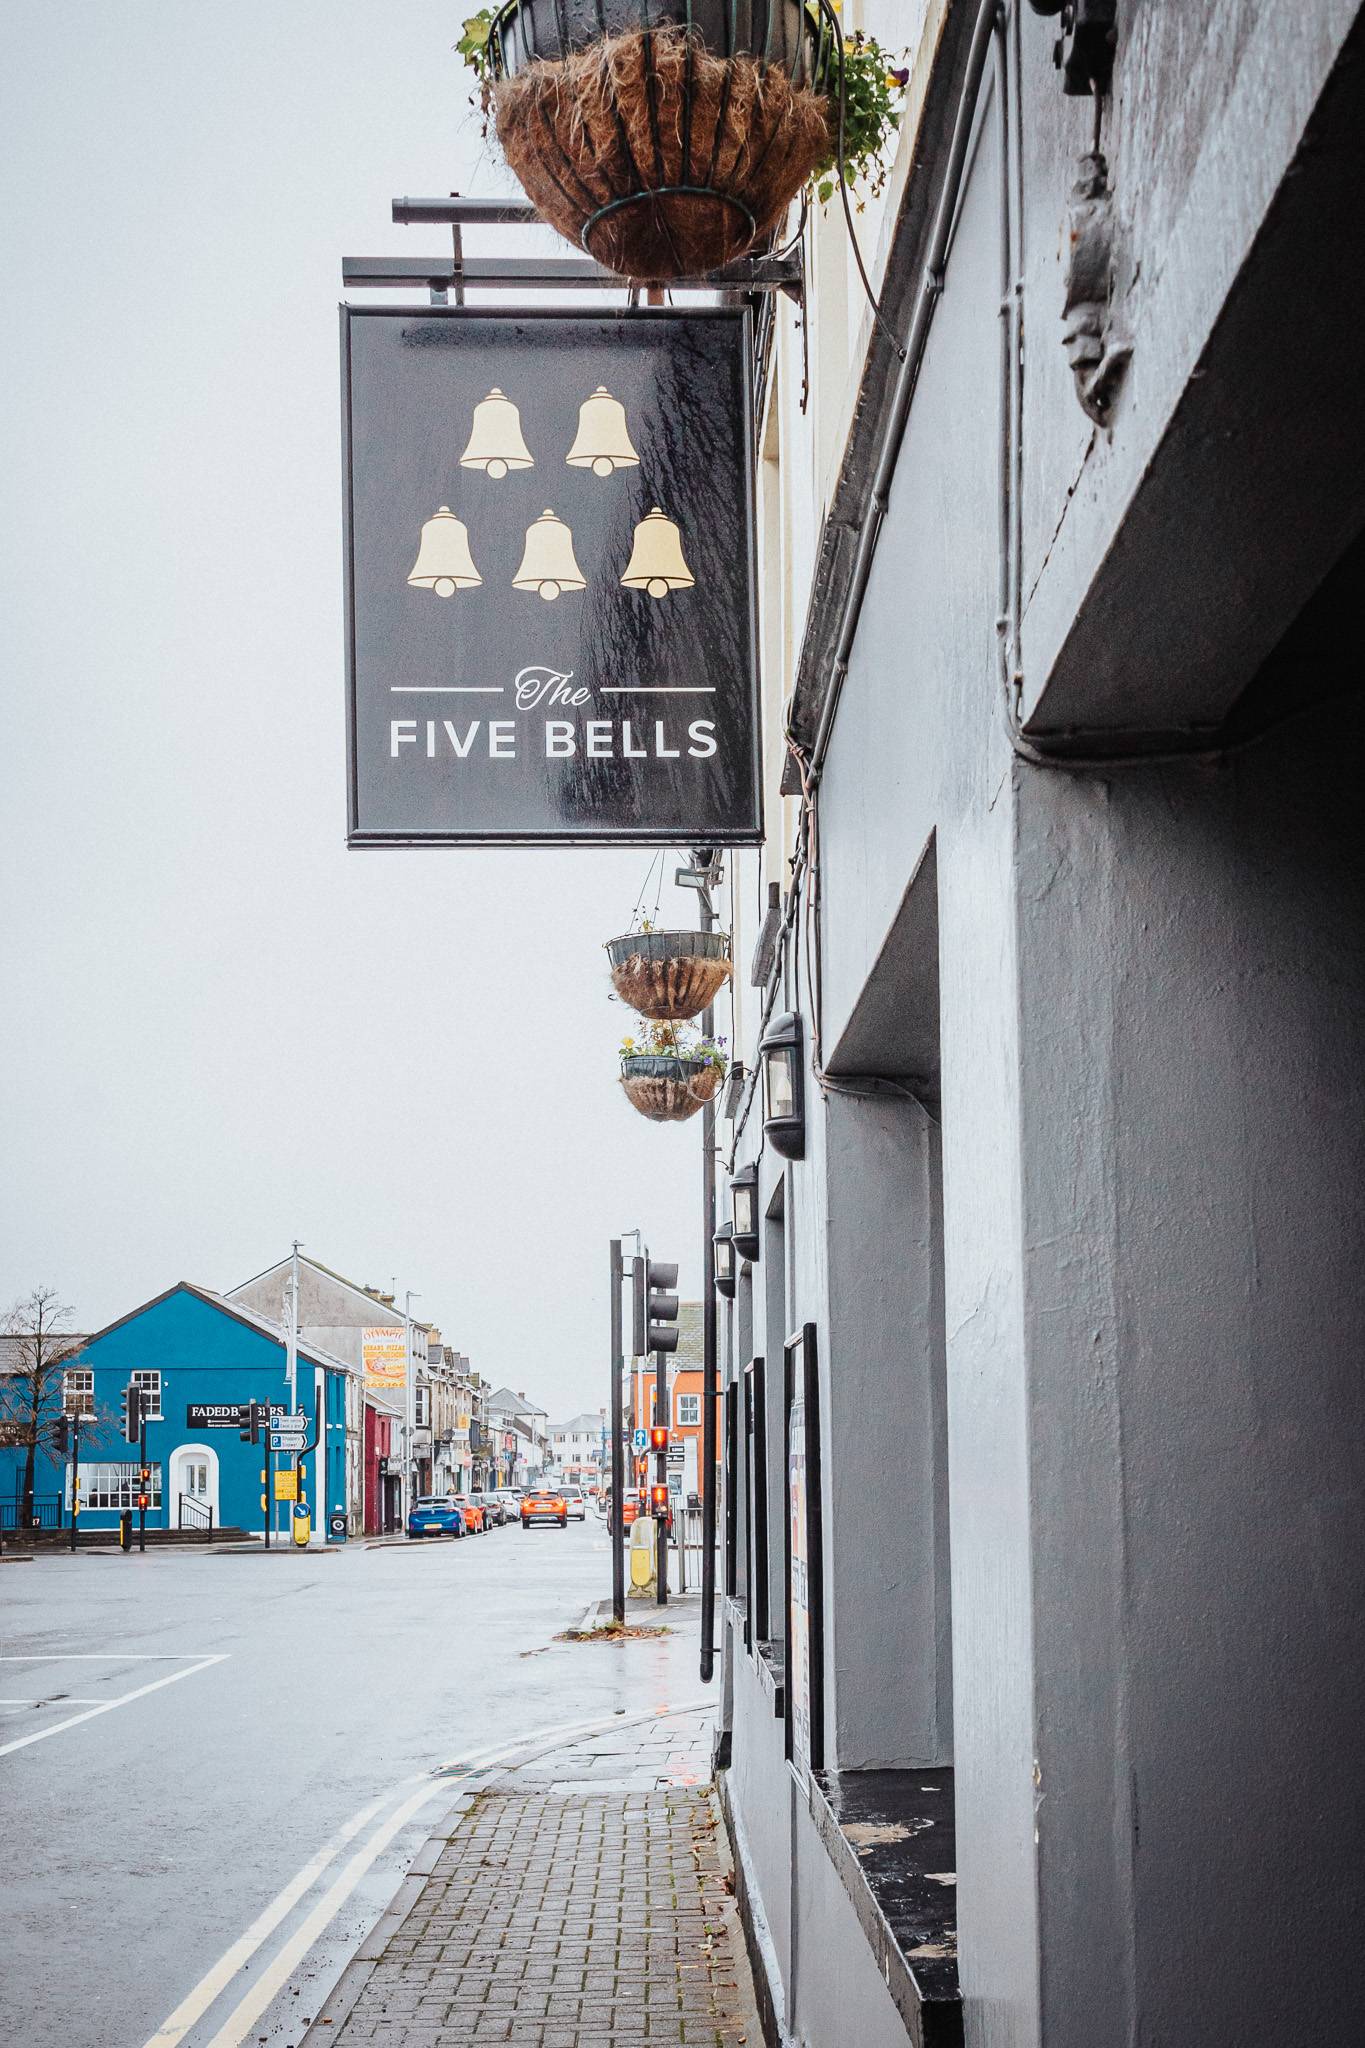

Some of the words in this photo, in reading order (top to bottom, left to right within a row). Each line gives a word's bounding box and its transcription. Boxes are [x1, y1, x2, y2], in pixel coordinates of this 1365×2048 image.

[515, 666, 591, 711] The
[390, 720, 516, 758] FIVE
[546, 719, 718, 758] BELLS
[191, 1406, 230, 1417] FADED
